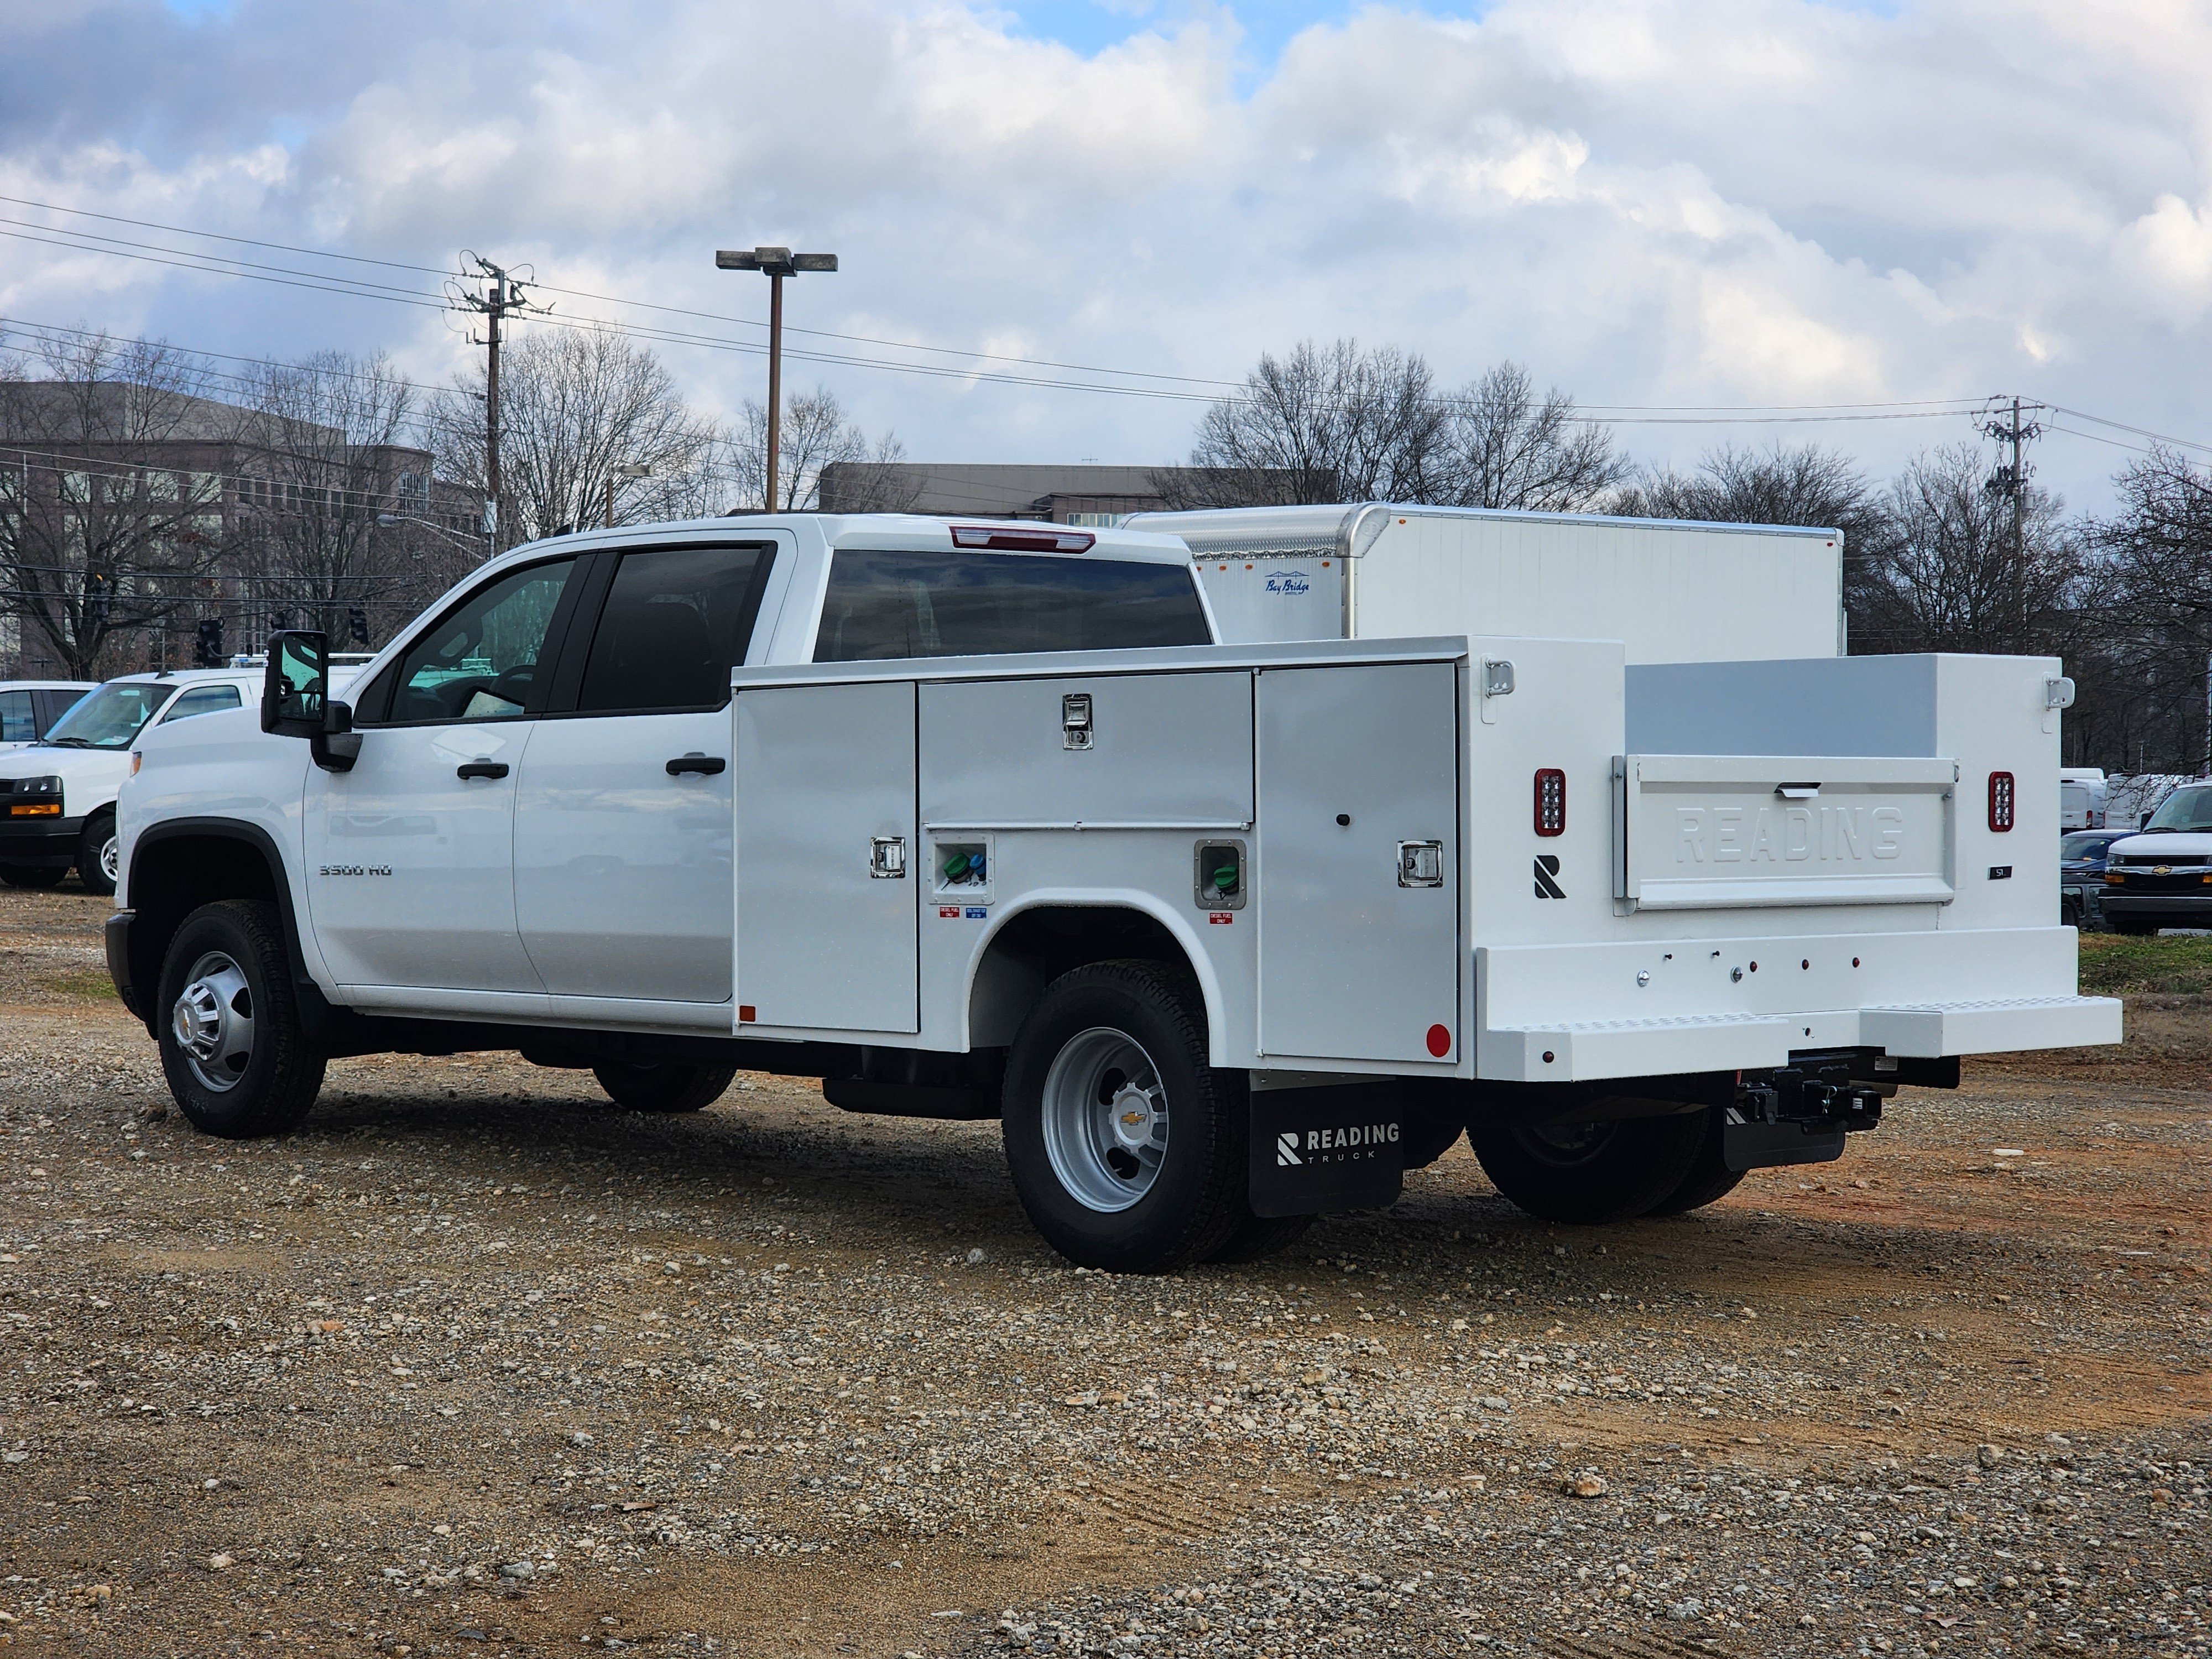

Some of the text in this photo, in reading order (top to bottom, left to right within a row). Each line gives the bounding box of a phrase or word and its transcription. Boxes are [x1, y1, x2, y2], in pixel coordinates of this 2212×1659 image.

[1265, 579, 1309, 595] Bay Bridge
[1676, 807, 1903, 863] READING
[319, 864, 364, 876] 3500
[1307, 1123, 1399, 1150] READING
[1308, 1151, 1375, 1164] TRUCK
